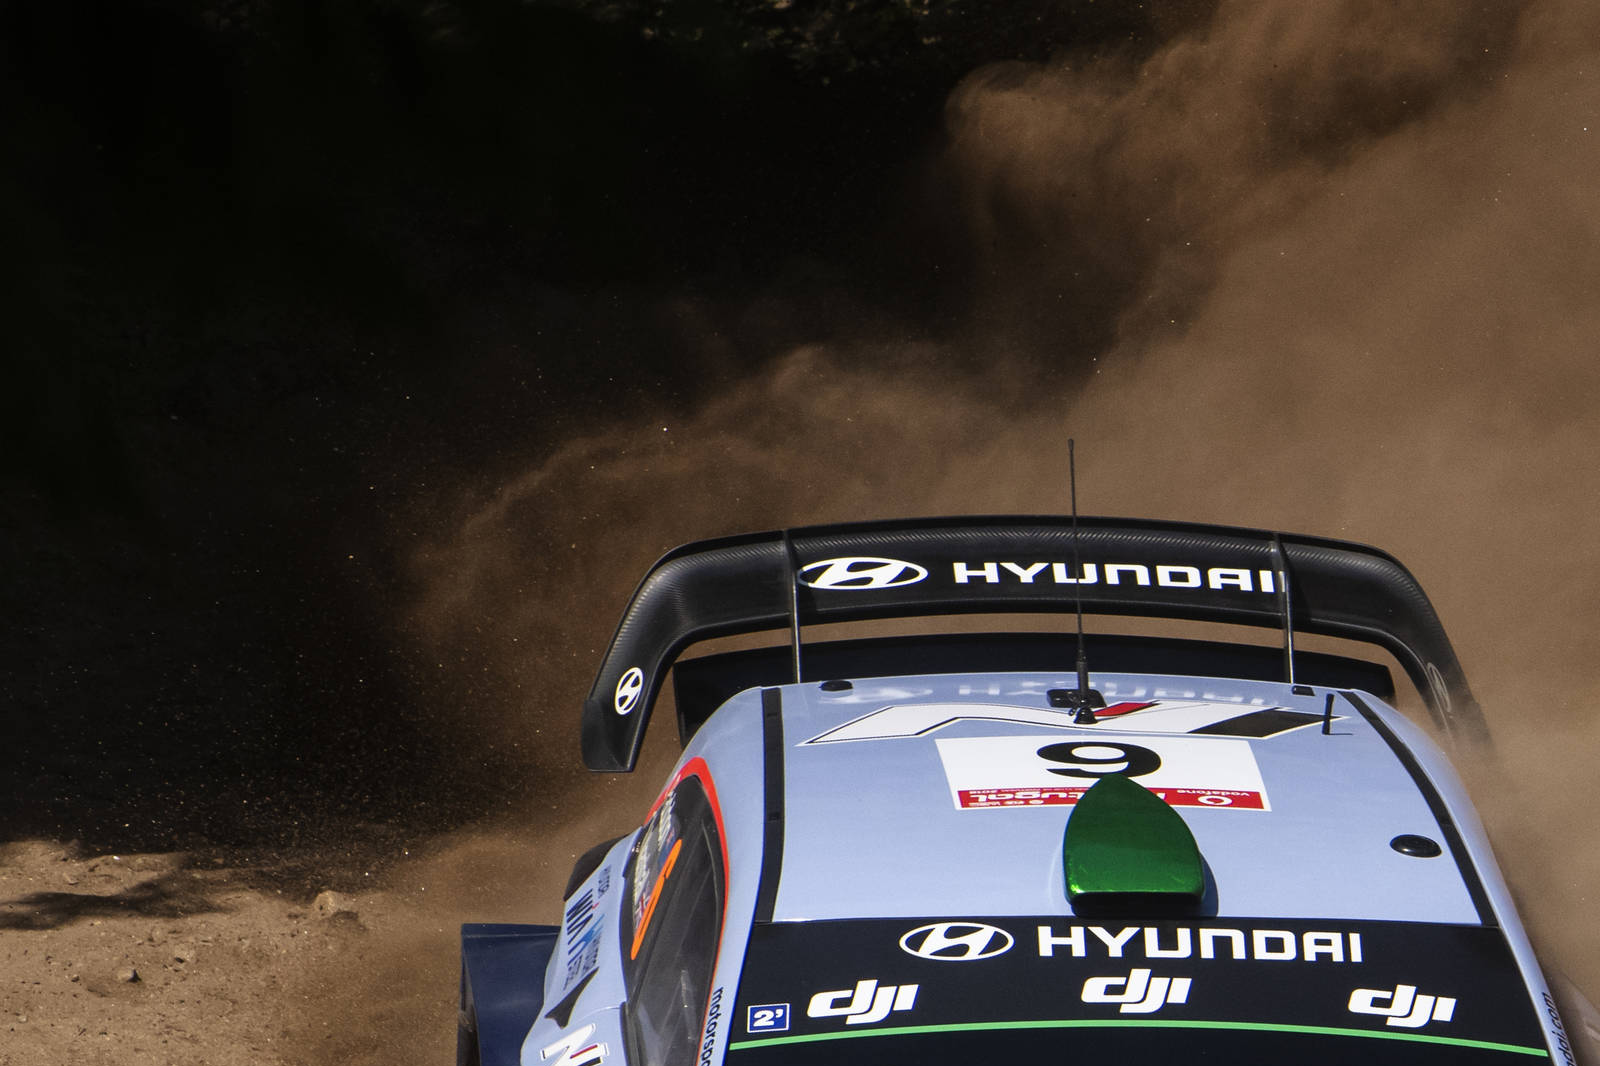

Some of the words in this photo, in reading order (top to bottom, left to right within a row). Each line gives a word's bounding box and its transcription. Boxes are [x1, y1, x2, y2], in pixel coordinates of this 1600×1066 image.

[953, 560, 1276, 593] HYUNDAI
[1176, 789, 1250, 797] vodafone
[1038, 926, 1363, 963] HYUNDAI
